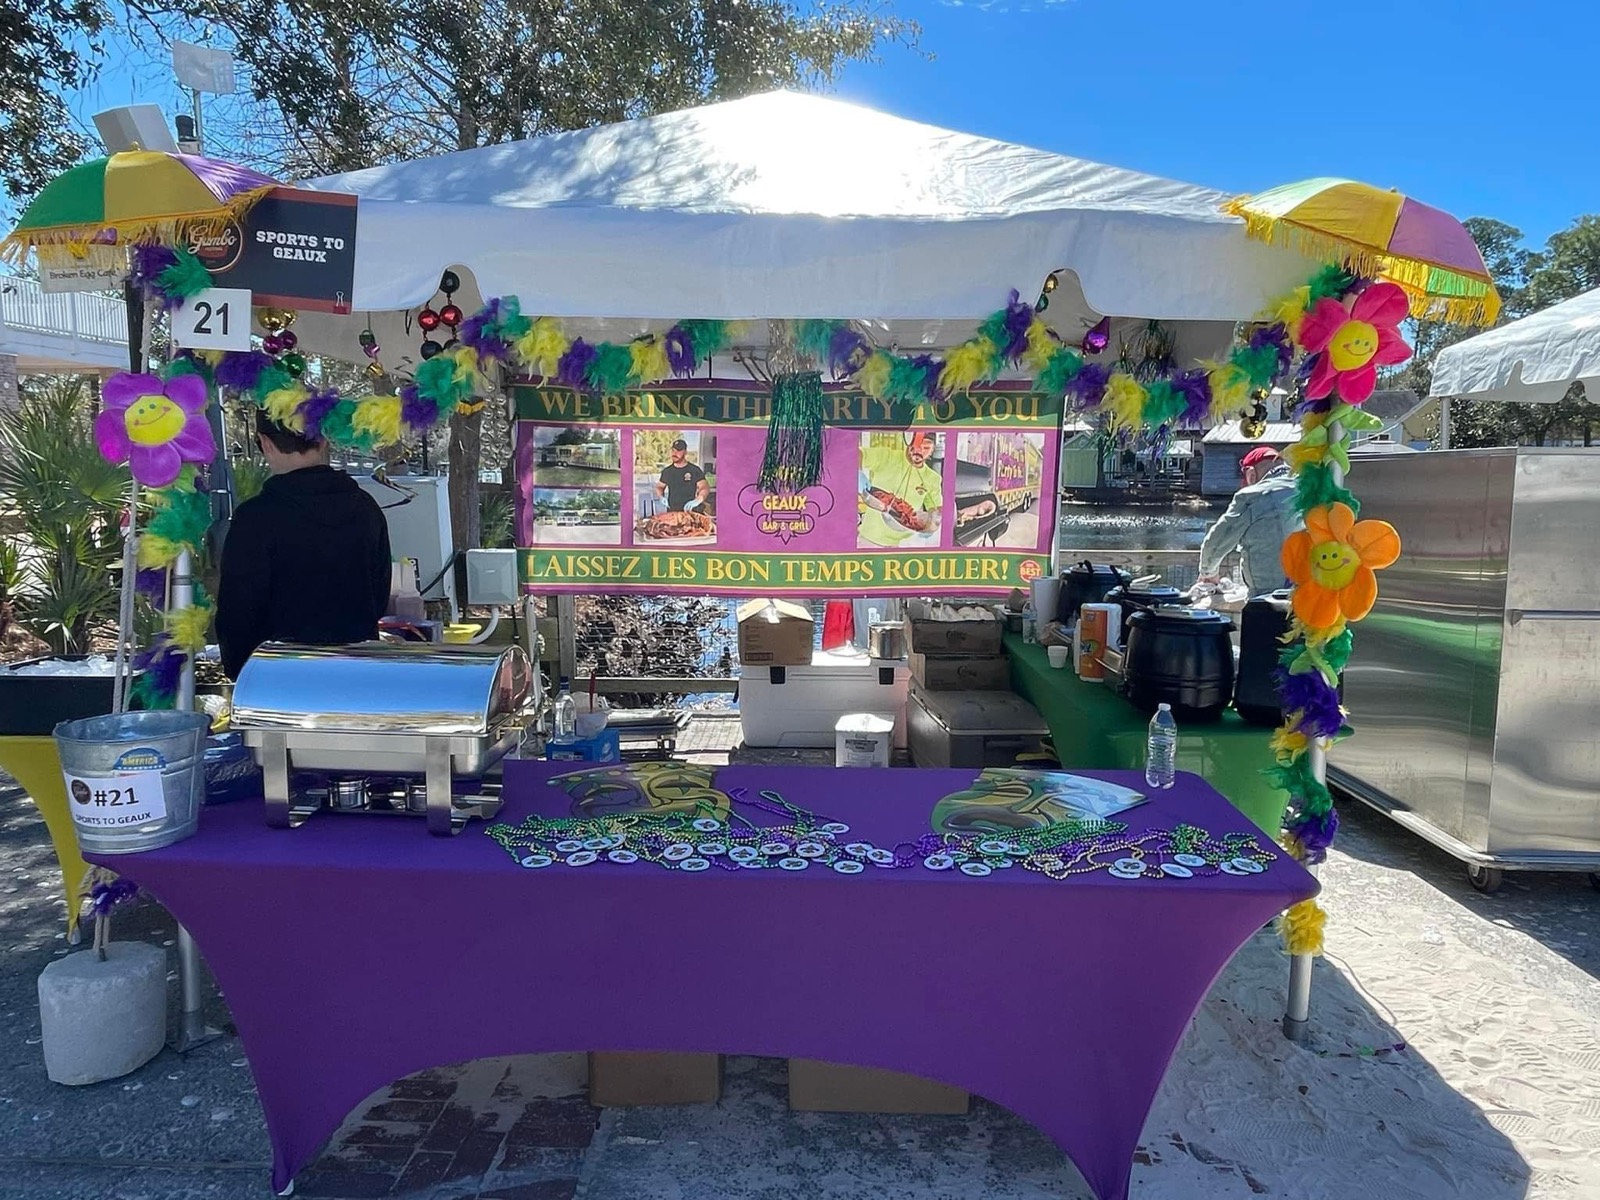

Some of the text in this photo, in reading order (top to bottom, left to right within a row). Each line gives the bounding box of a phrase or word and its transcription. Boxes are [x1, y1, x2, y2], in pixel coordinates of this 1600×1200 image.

[256, 230, 344, 250] SPORTS TO
[273, 246, 327, 263] GEAUX
[49, 269, 78, 280] Broken
[80, 269, 96, 281] Egg
[193, 301, 229, 335] 21
[540, 391, 590, 417] WE
[602, 393, 706, 418] BRING
[969, 396, 1039, 422] YOU
[762, 495, 808, 510] GEAUX
[762, 521, 810, 531] BAR & GRILL
[526, 555, 1010, 582] LAISSEZ LES BON TEMPS ROULER!
[1020, 567, 1042, 577] BEST
[94, 786, 139, 807] #21
[75, 811, 152, 825] SPORTS TO GEAUX
